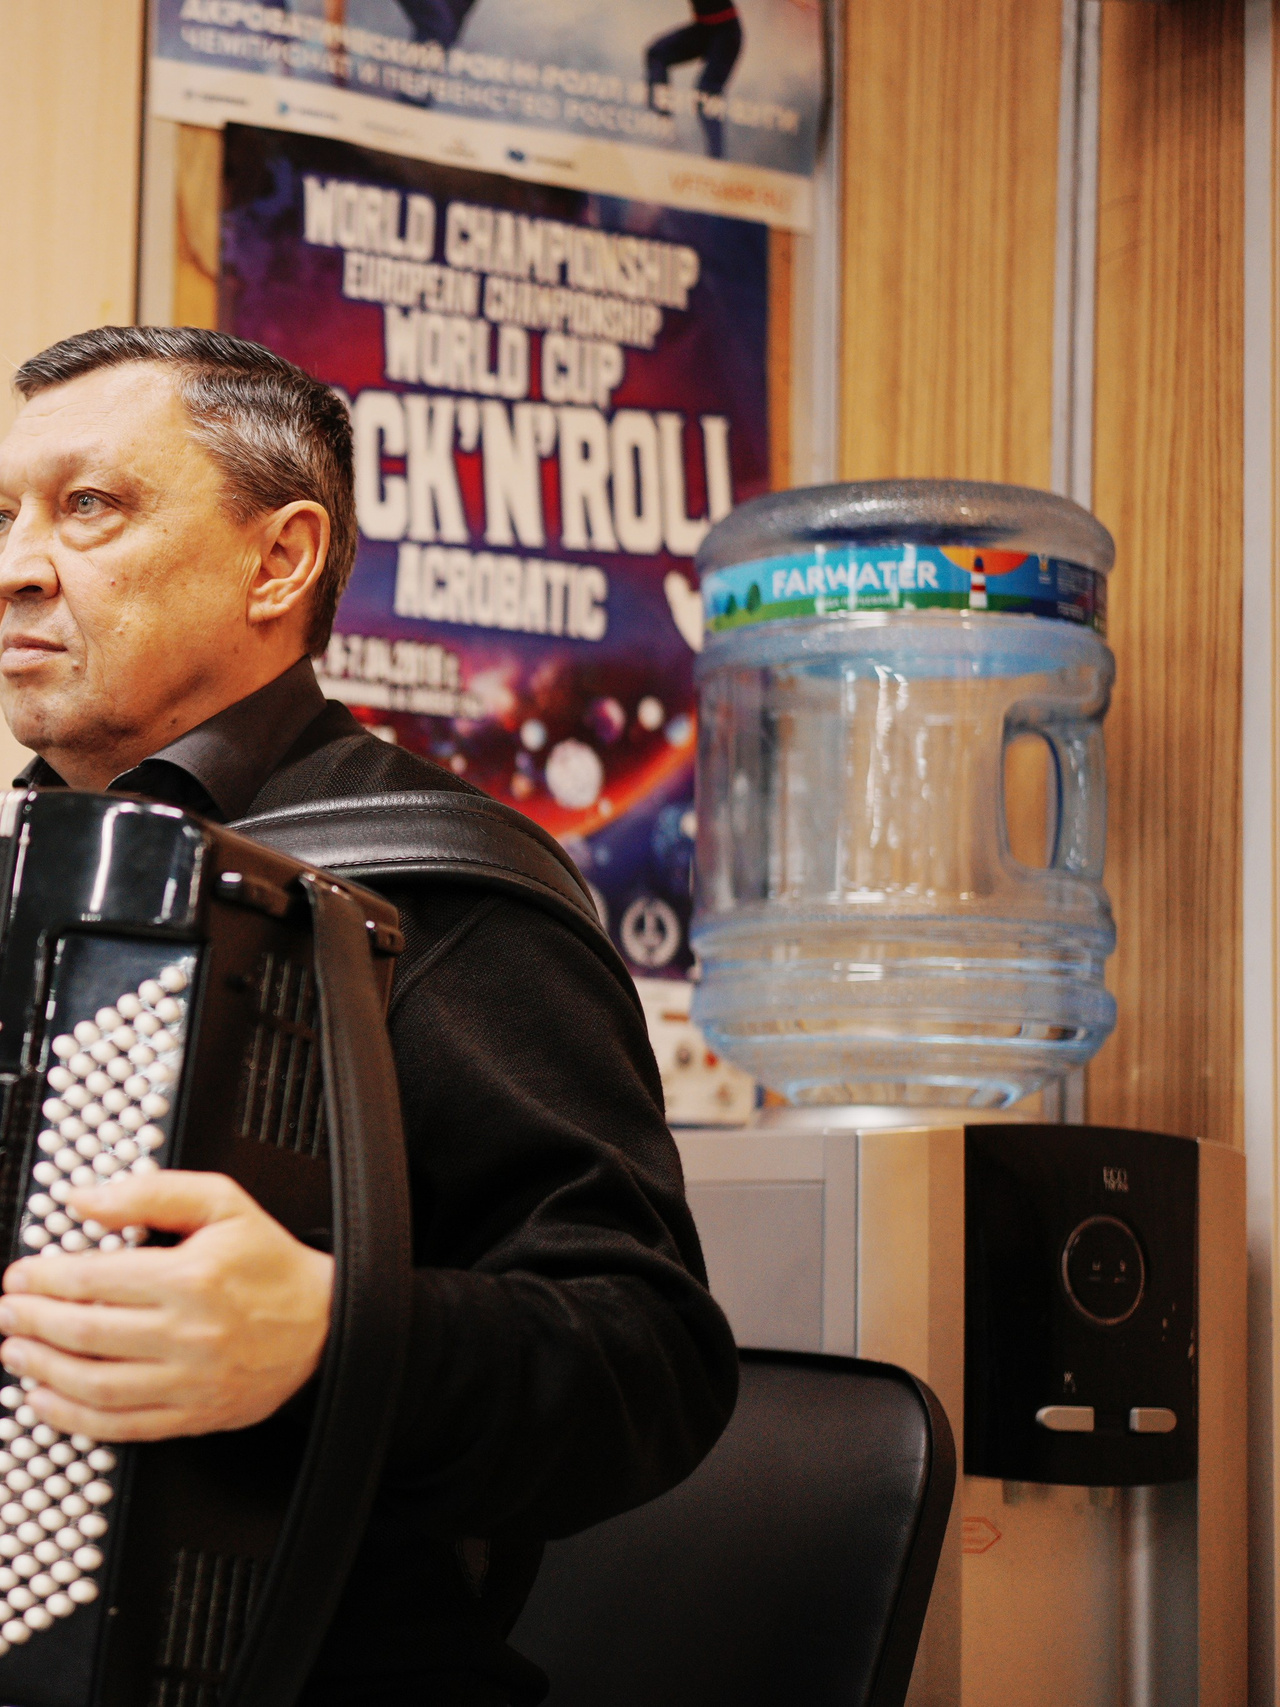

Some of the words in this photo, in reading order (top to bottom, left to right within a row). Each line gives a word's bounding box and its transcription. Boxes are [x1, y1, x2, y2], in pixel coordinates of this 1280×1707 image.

[303, 174, 437, 262] WORLD
[445, 200, 701, 310] CHAMPIONSHIP
[343, 252, 480, 319] EUROPEAN
[485, 275, 664, 350] CHAMPIONSHIP
[384, 305, 531, 398] WORLD
[541, 335, 626, 408] CUP
[334, 384, 734, 557] CK'N'ROLL
[393, 541, 609, 643] ACROBATIC
[772, 560, 940, 599] FARWATER
